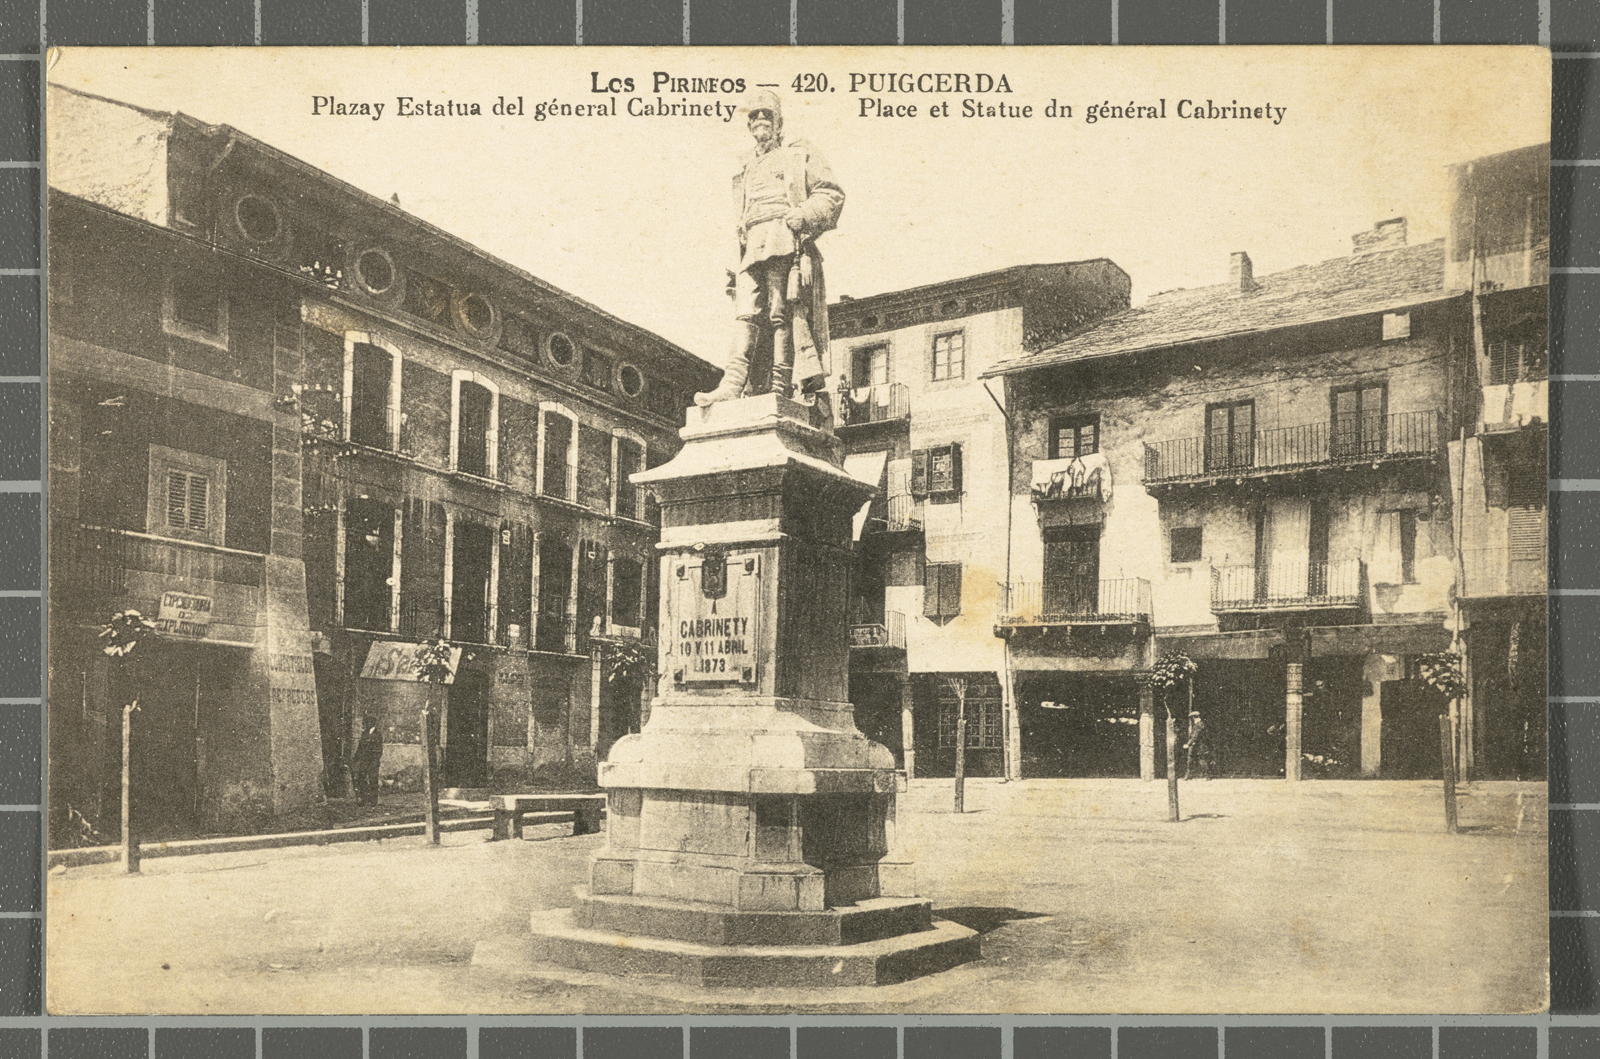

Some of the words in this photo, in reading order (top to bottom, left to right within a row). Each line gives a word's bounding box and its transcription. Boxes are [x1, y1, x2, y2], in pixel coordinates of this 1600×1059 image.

[680, 617, 748, 639] CABRINETY
[718, 639, 748, 655] ABRIL
[700, 658, 726, 673] 1873
